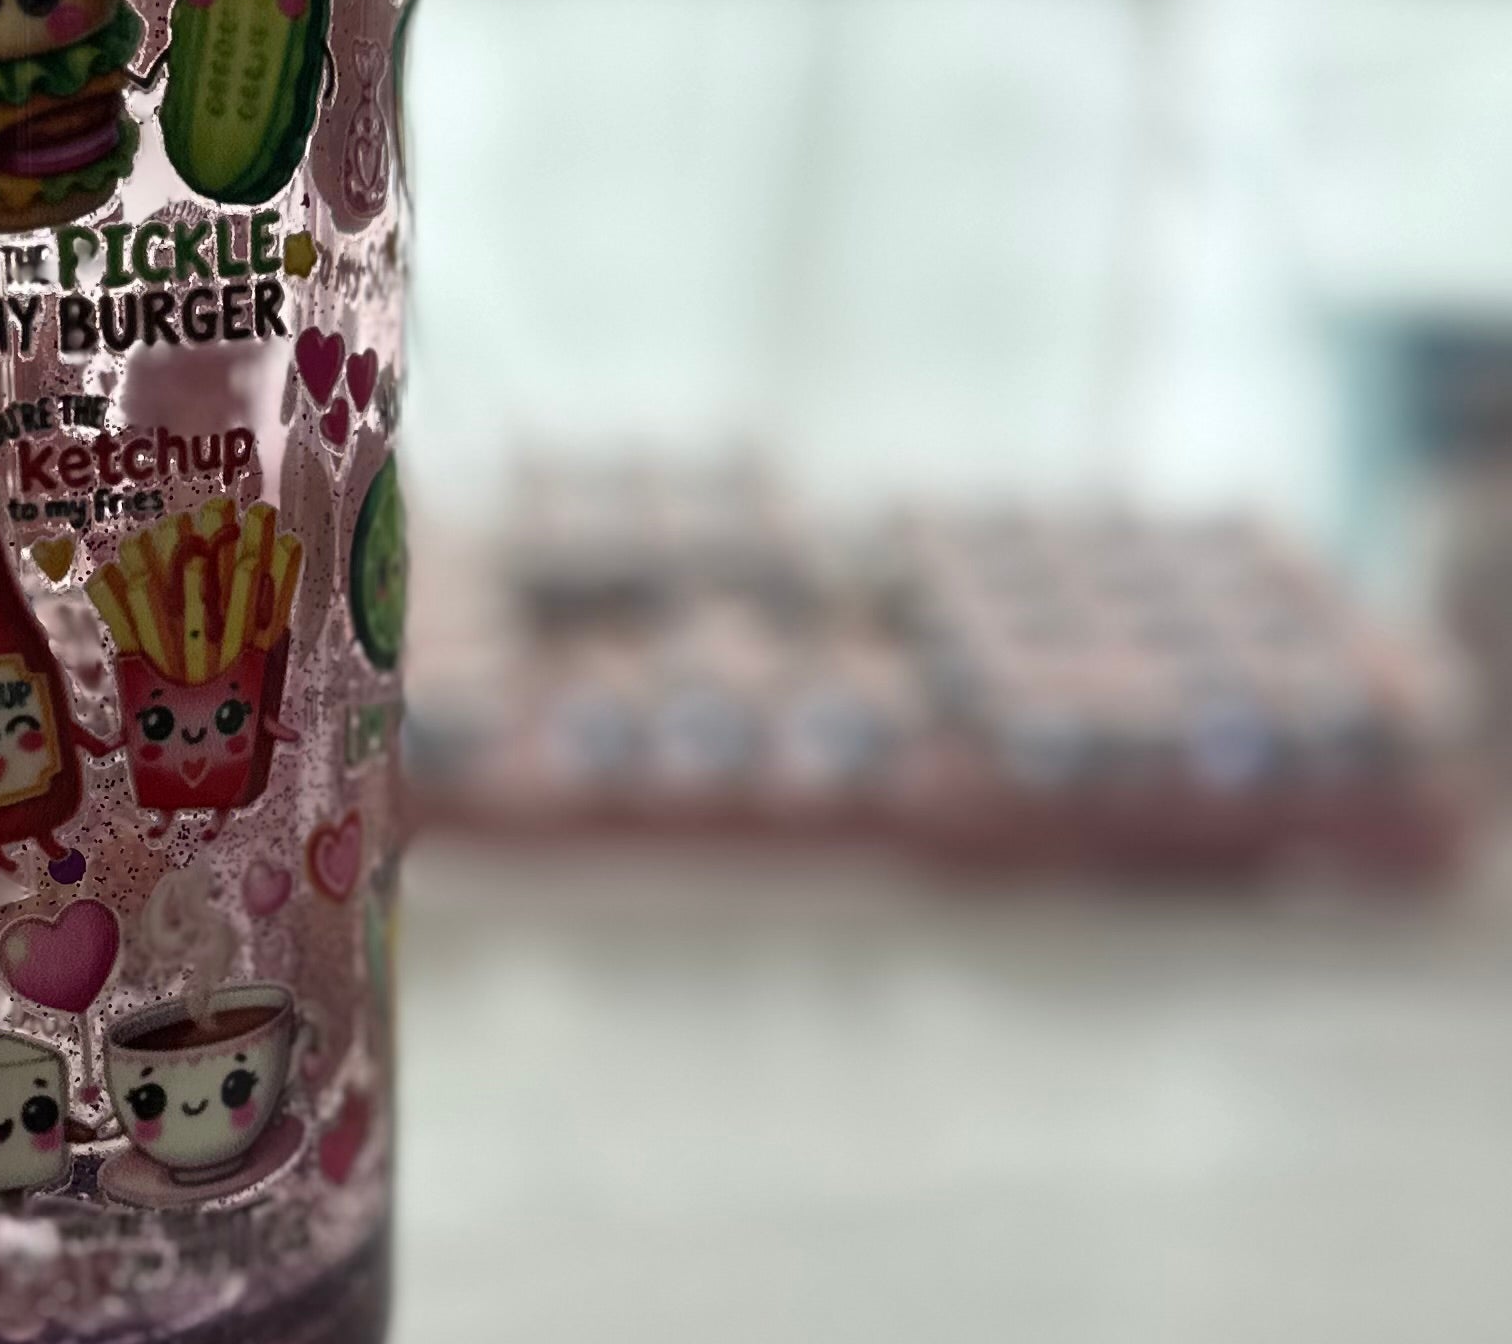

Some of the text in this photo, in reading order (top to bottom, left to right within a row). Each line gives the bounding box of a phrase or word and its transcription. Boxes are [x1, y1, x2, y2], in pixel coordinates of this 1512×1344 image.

[57, 208, 284, 290] PICKLE
[59, 278, 289, 354] BURGER
[57, 394, 110, 429] THE
[8, 488, 165, 529] to my fries
